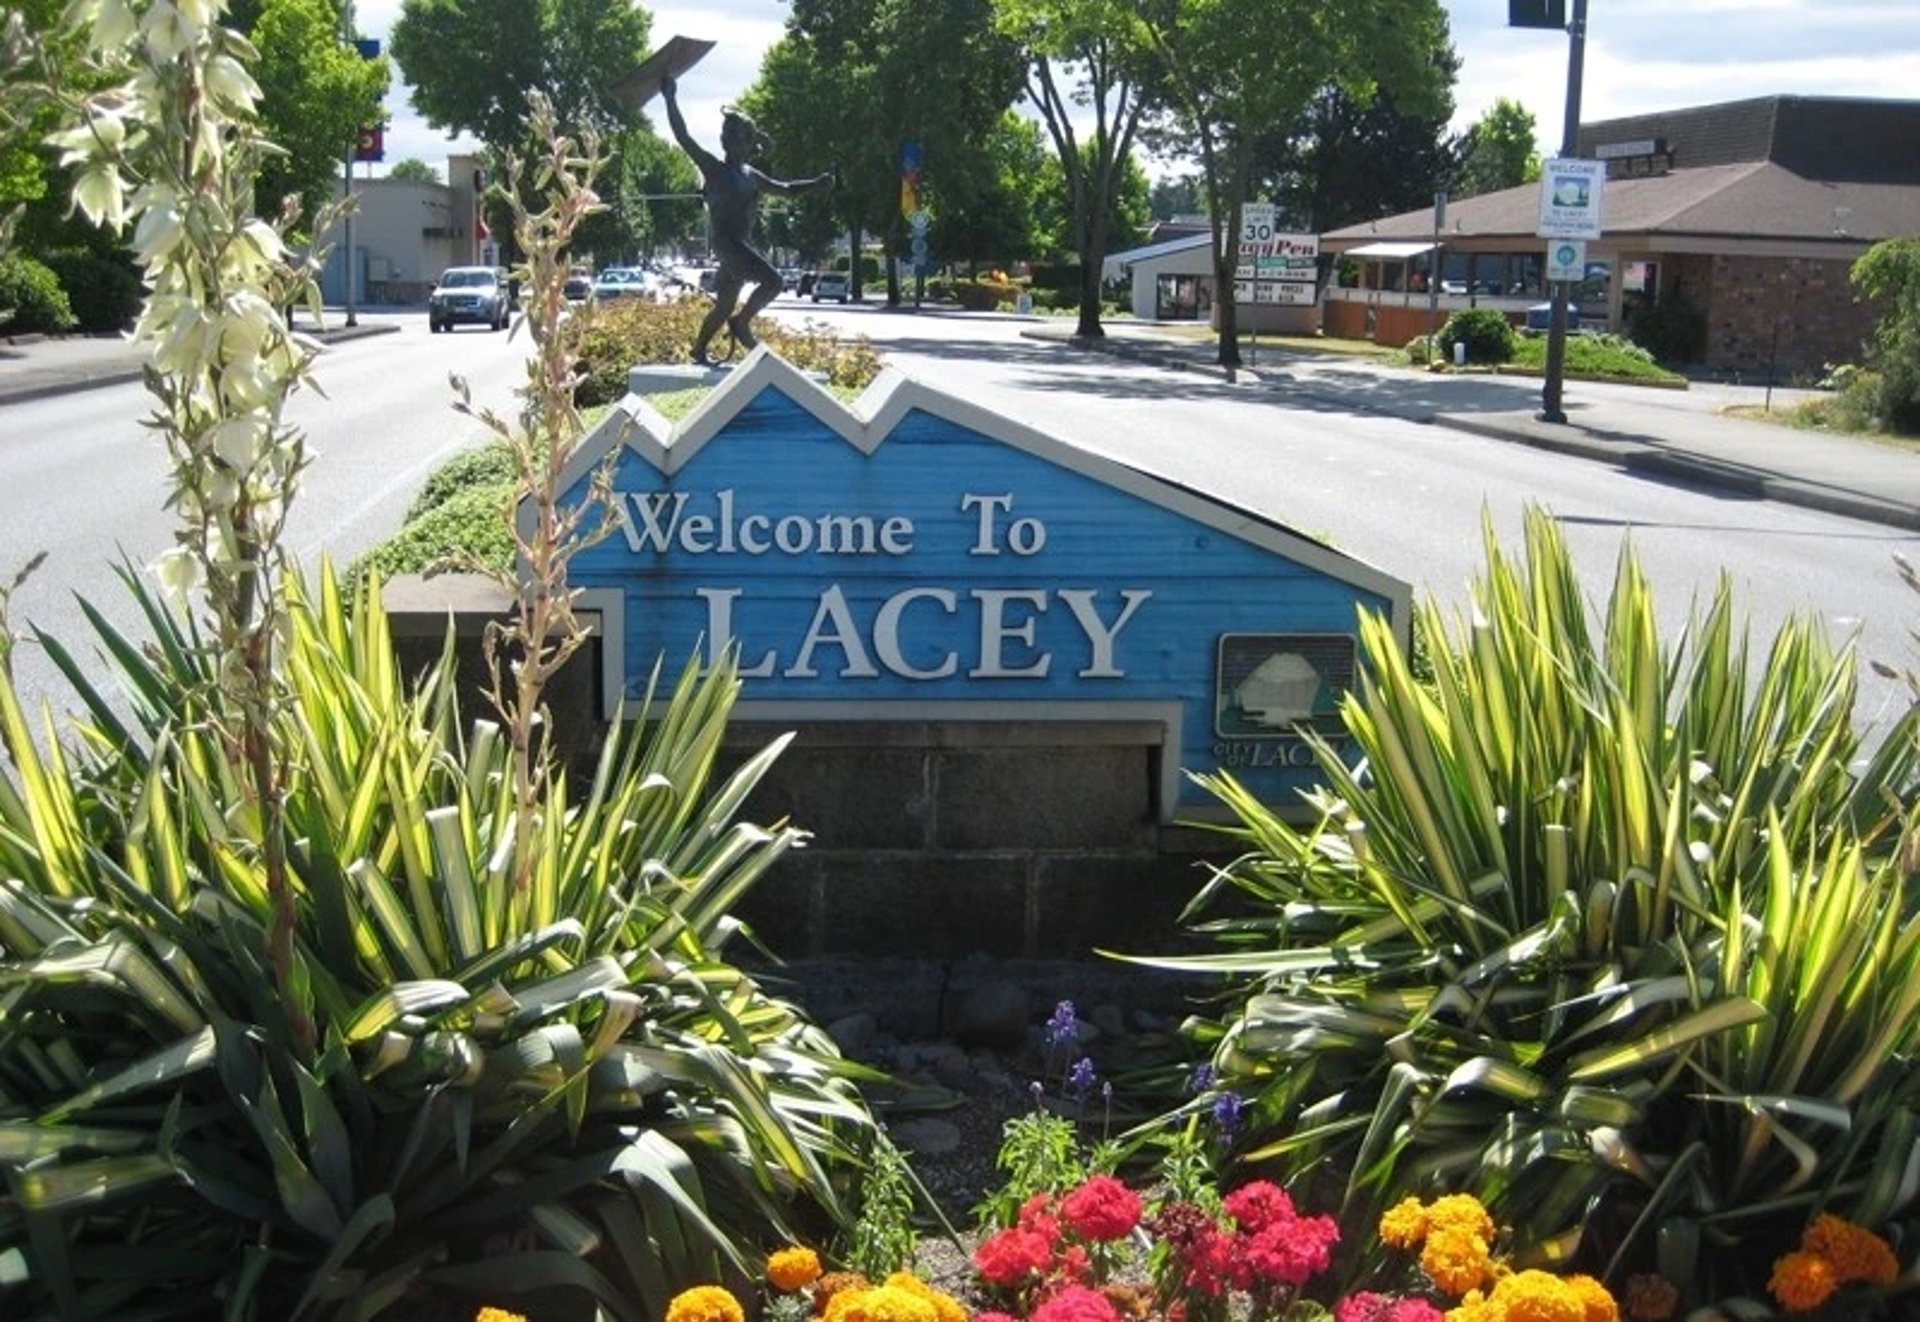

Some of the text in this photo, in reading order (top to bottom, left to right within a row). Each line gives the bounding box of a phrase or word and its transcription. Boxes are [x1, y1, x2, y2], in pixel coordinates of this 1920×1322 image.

[1245, 225, 1270, 240] 30
[1275, 240, 1315, 255] Pen
[615, 489, 1047, 556] Welcome To
[696, 583, 1153, 680] LACEY
